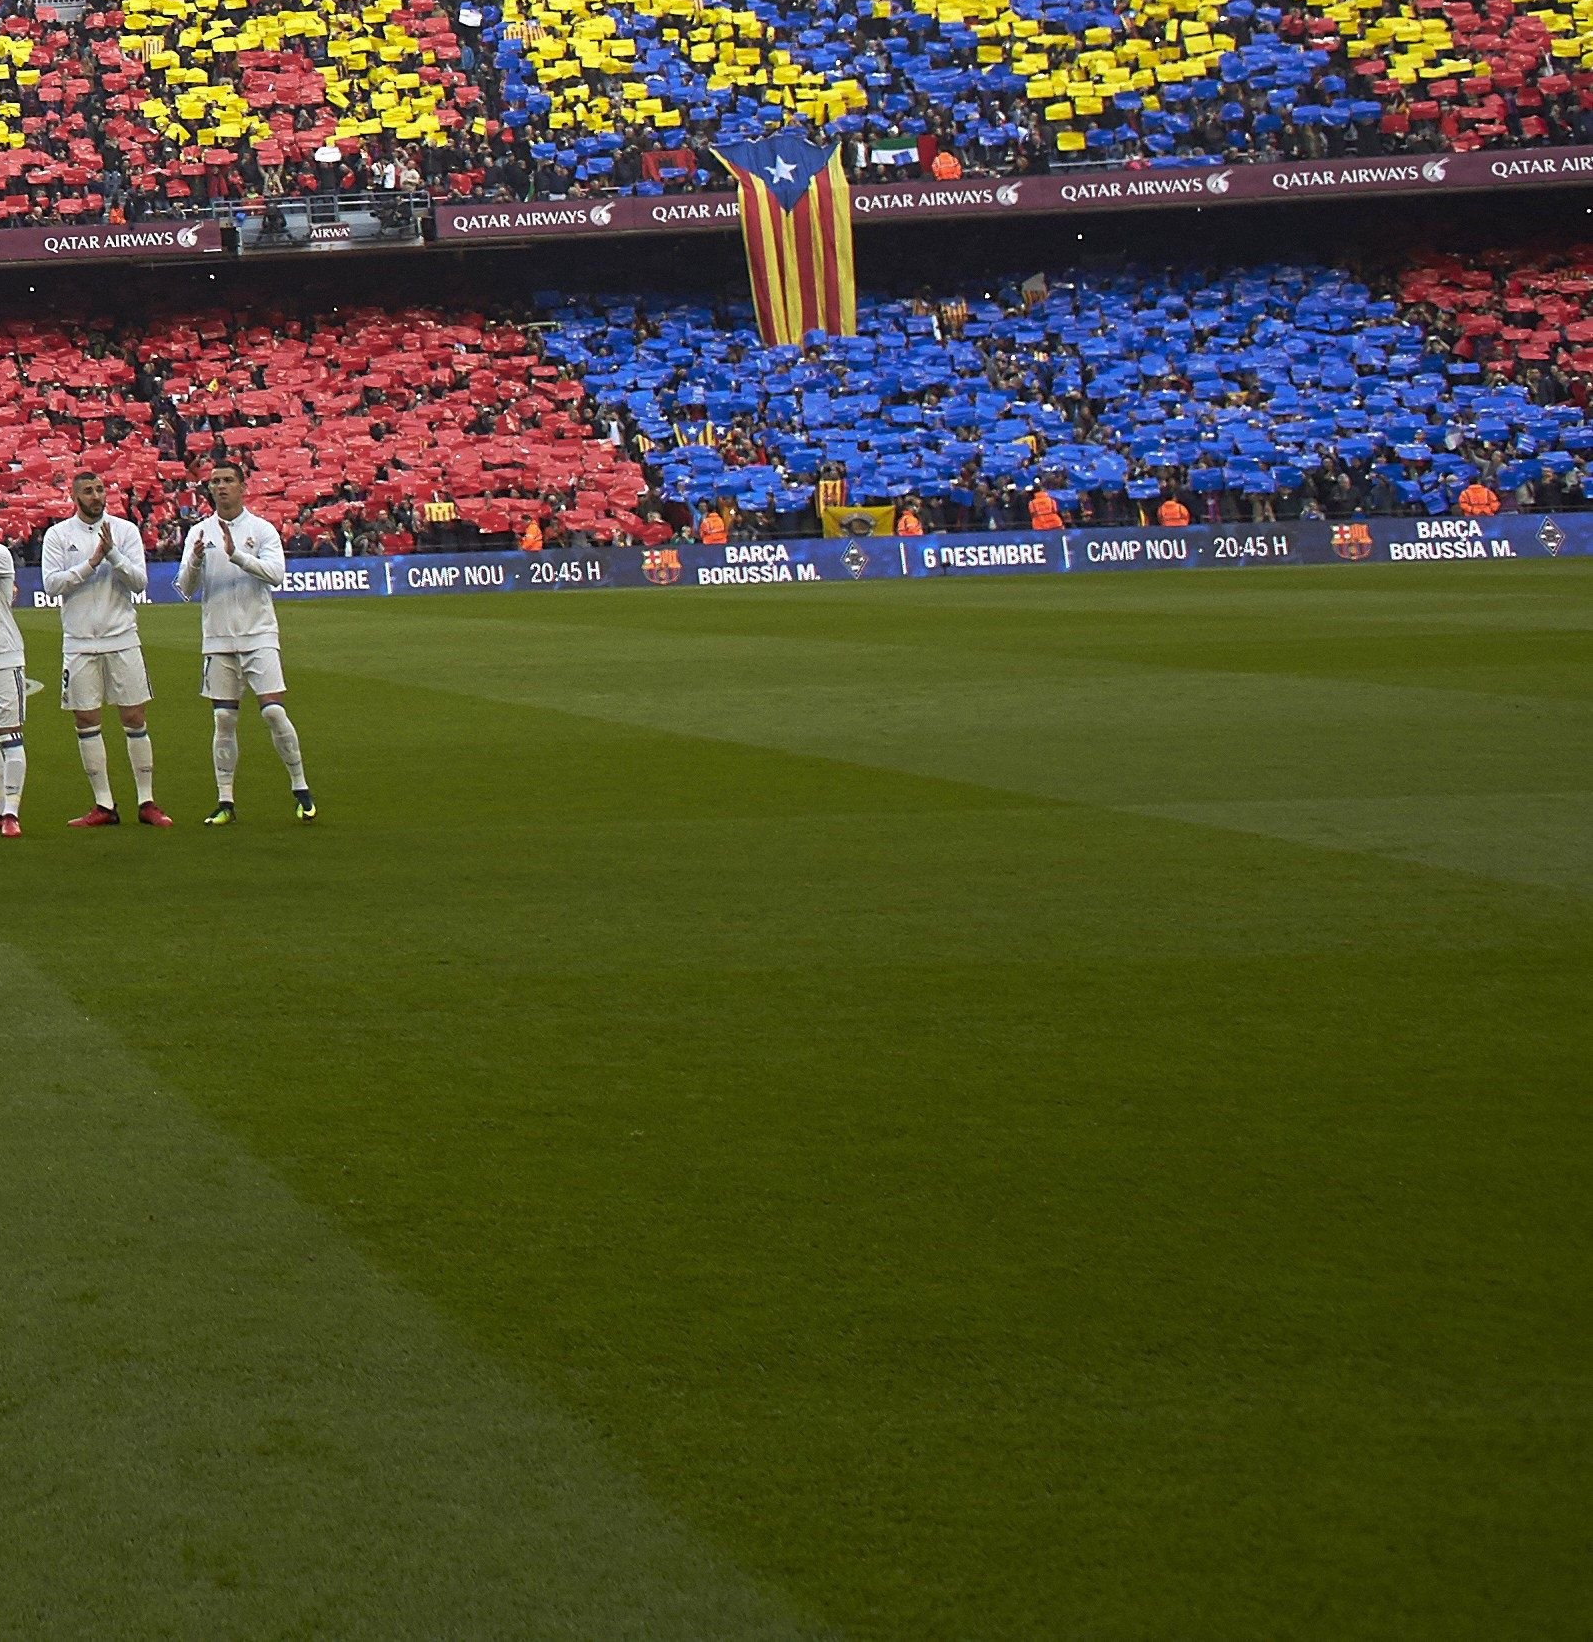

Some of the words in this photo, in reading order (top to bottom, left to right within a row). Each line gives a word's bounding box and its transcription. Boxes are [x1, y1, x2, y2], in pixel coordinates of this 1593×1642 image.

[1272, 170, 1335, 190] QATAR
[1337, 166, 1420, 185] AIRWAYS
[1490, 159, 1554, 178] QATAR
[1557, 157, 1593, 172] AIR
[855, 192, 916, 212] QATAR
[919, 188, 995, 207] AIRWAYS
[1060, 182, 1120, 201] QATAR
[1123, 177, 1203, 195] AIRWAYS
[453, 215, 510, 232] QATAR
[513, 210, 588, 227] AIRWAYS
[651, 204, 709, 222] QATAR
[44, 235, 101, 252] QATAR
[104, 231, 174, 247] AIRWAYS
[1416, 520, 1483, 542] BARÇA
[725, 544, 790, 566] BARÇA
[922, 548, 936, 568] 6
[939, 543, 1047, 567] DESEMBRE
[1086, 541, 1143, 563] CAMP
[1148, 538, 1187, 560] NOU
[1212, 536, 1268, 558] 20:45
[1272, 535, 1288, 555] H
[1389, 539, 1486, 561] BORUSSIA
[1490, 538, 1516, 557] M.
[271, 569, 370, 592] ESEMBRE
[407, 566, 459, 588] CAMP
[464, 564, 504, 585] NOU
[529, 561, 583, 583] 20:45
[587, 562, 601, 580] H
[697, 563, 792, 584] BORUSSIA
[795, 563, 821, 581] M.
